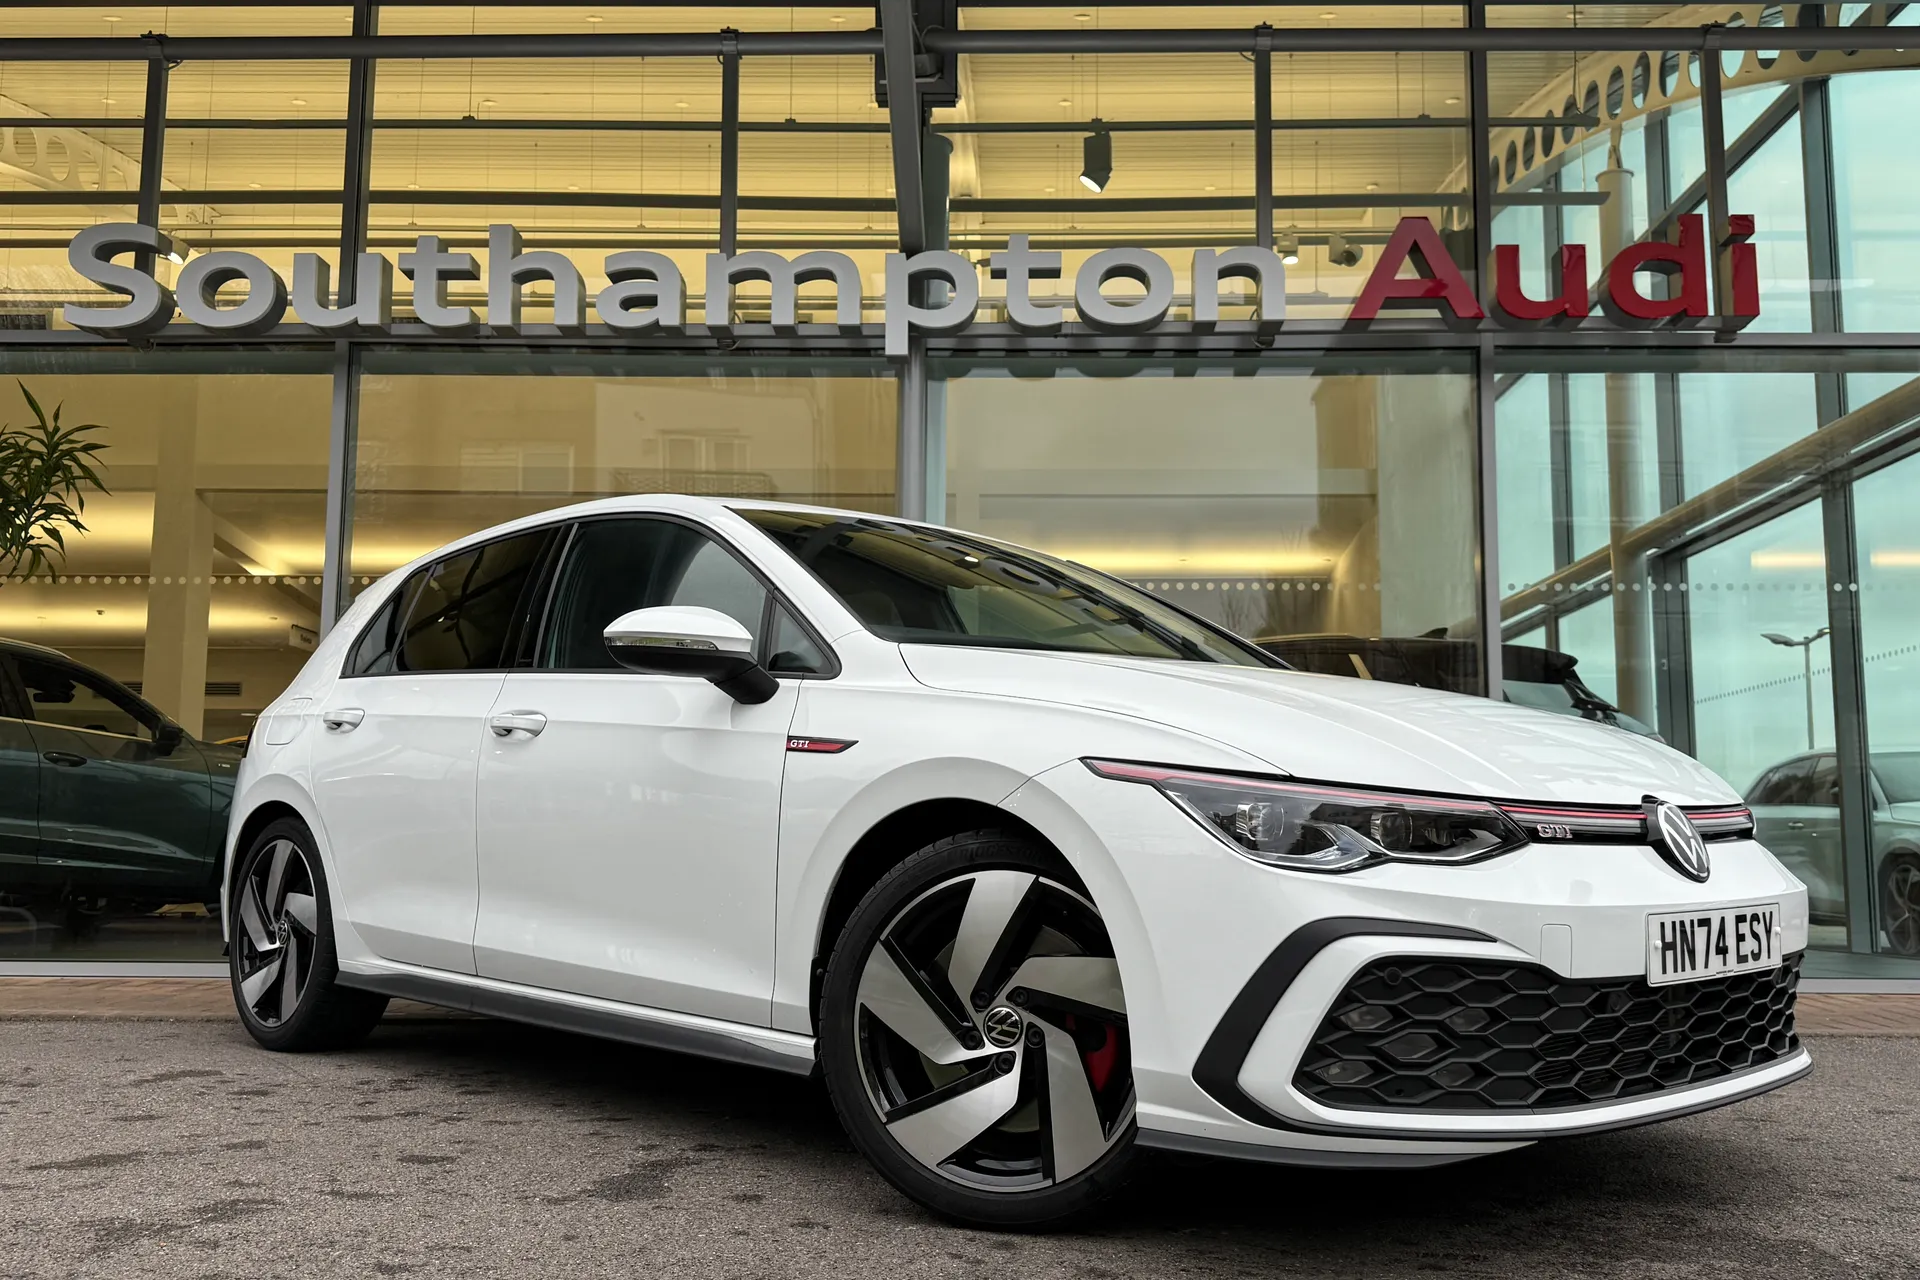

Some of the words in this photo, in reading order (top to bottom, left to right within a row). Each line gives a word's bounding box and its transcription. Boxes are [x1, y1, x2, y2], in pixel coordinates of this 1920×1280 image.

[65, 222, 1287, 355] Southampton
[1348, 214, 1760, 319] Audi
[790, 740, 809, 748] GTI
[1537, 824, 1573, 839] GTI
[1660, 916, 1728, 974] HN74
[1735, 910, 1773, 964] ESY
